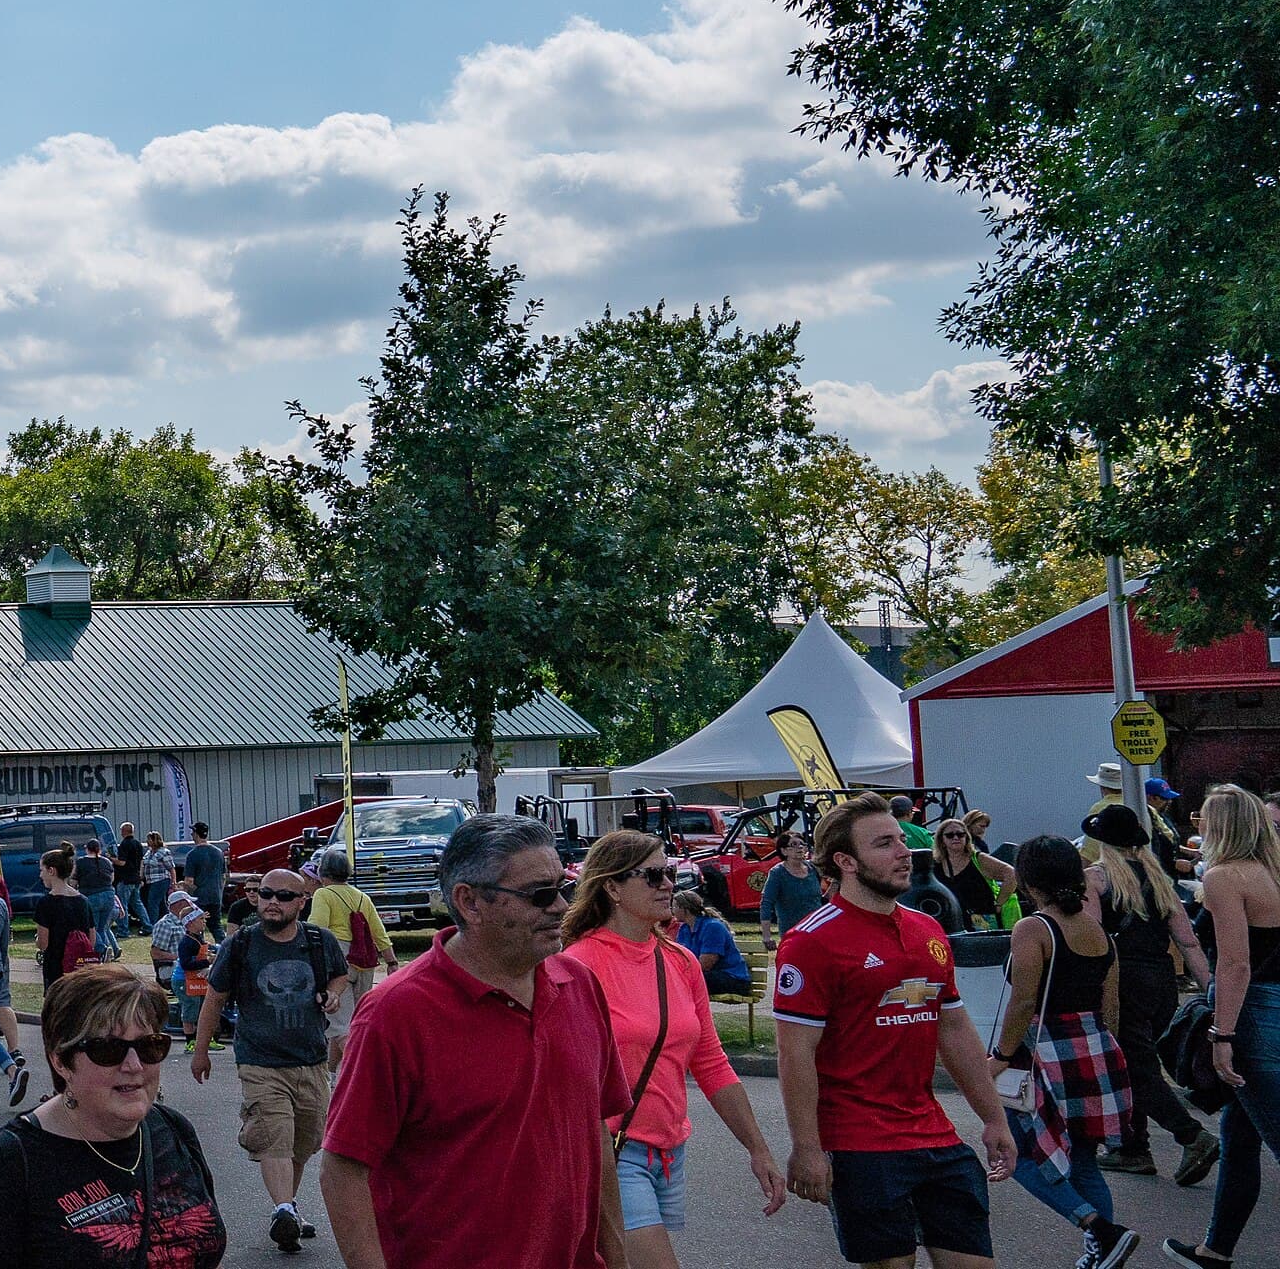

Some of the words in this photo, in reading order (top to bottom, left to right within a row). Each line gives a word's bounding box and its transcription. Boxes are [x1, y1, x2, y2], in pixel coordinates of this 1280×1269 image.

[1129, 729, 1151, 738] FREE
[1120, 738, 1159, 747] TROLLEY
[115, 762, 162, 793] INC.
[864, 960, 885, 969] adidas
[875, 1011, 938, 1026] CHEVROL
[70, 1210, 90, 1223] WHEN
[89, 1207, 97, 1217] WE
[96, 1202, 113, 1214] WERE
